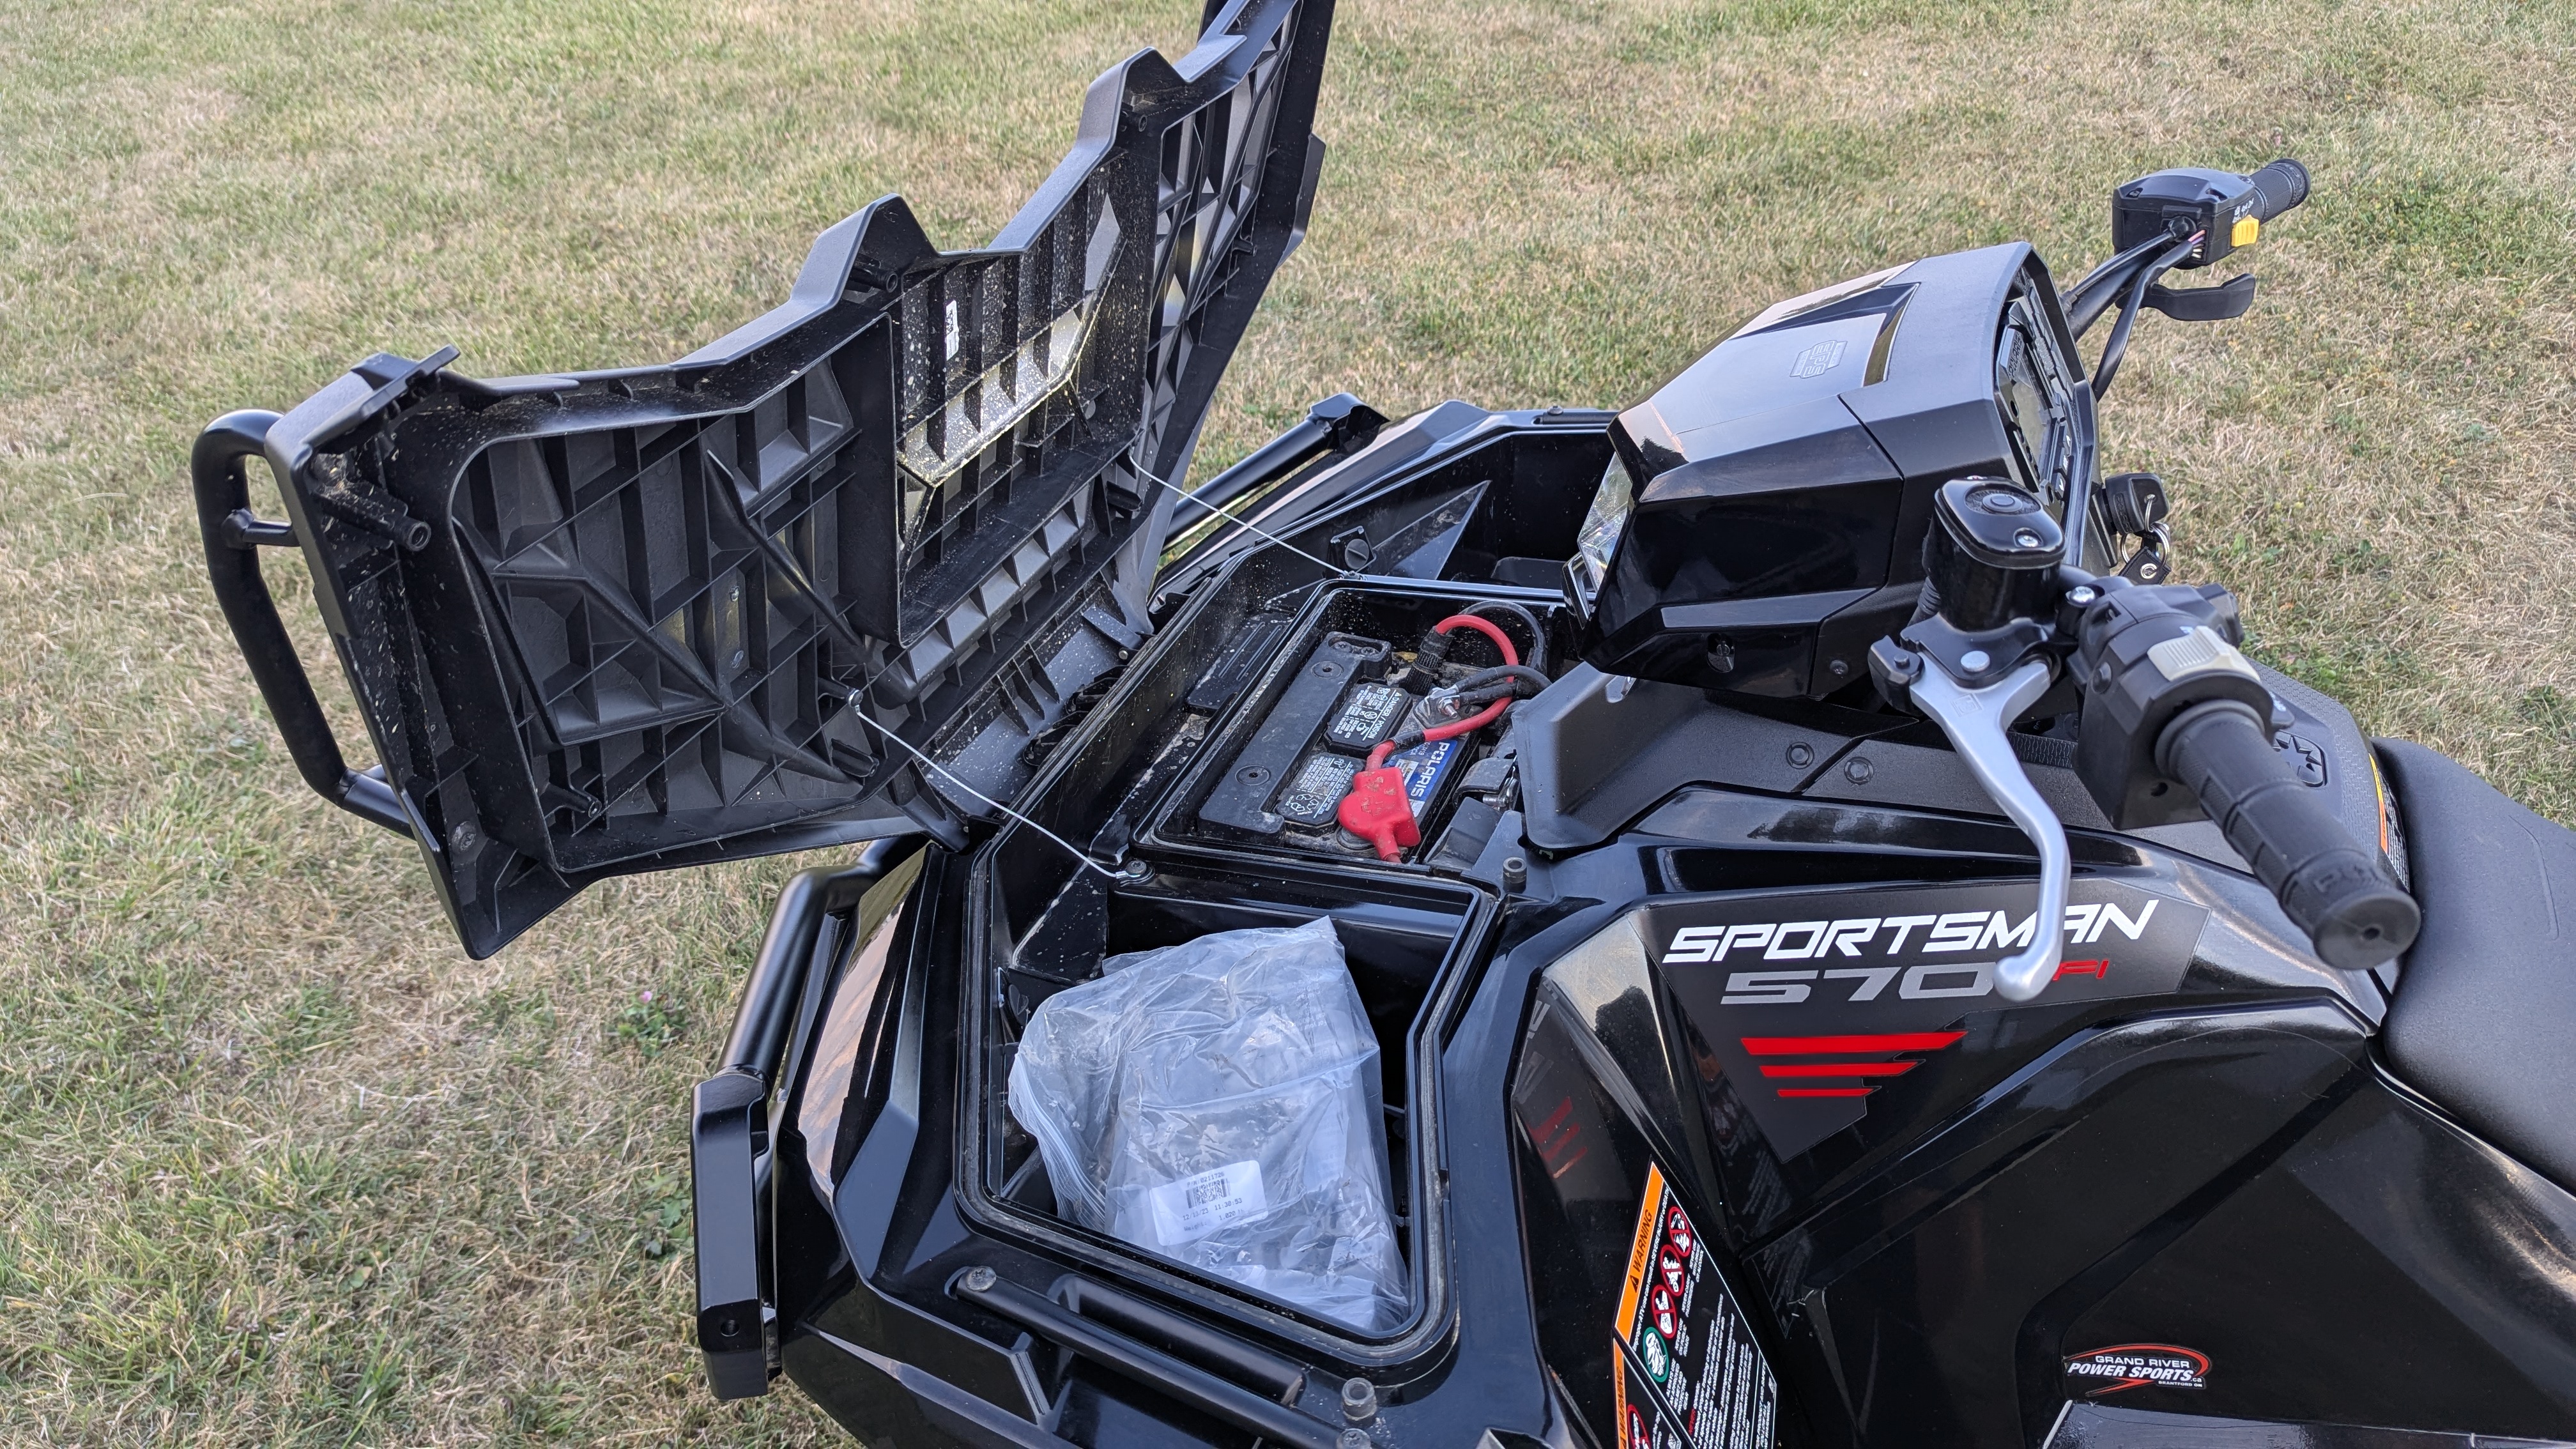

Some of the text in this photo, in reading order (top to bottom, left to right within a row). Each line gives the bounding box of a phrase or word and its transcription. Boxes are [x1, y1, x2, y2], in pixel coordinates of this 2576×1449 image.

[1382, 696, 1399, 717] DANGER
[1368, 720, 1385, 739] POISON
[1411, 742, 1451, 797] POLARIS
[1662, 900, 2161, 963] SPORTSMAN
[1721, 959, 2110, 1005] 570 FI
[1215, 1197, 1243, 1211] 11:30:53
[1632, 1209, 1653, 1273] WARNING
[1632, 1321, 1641, 1351] Improper
[1652, 1234, 1660, 1261] SEVERE
[1685, 1280, 1694, 1317] PASSENGERS
[1671, 1363, 1680, 1396] APPROVED
[2067, 1362, 2126, 1377] POWER
[2095, 1355, 2190, 1368] GRAND RIVER
[1677, 1376, 1687, 1415] PROTECTIVE
